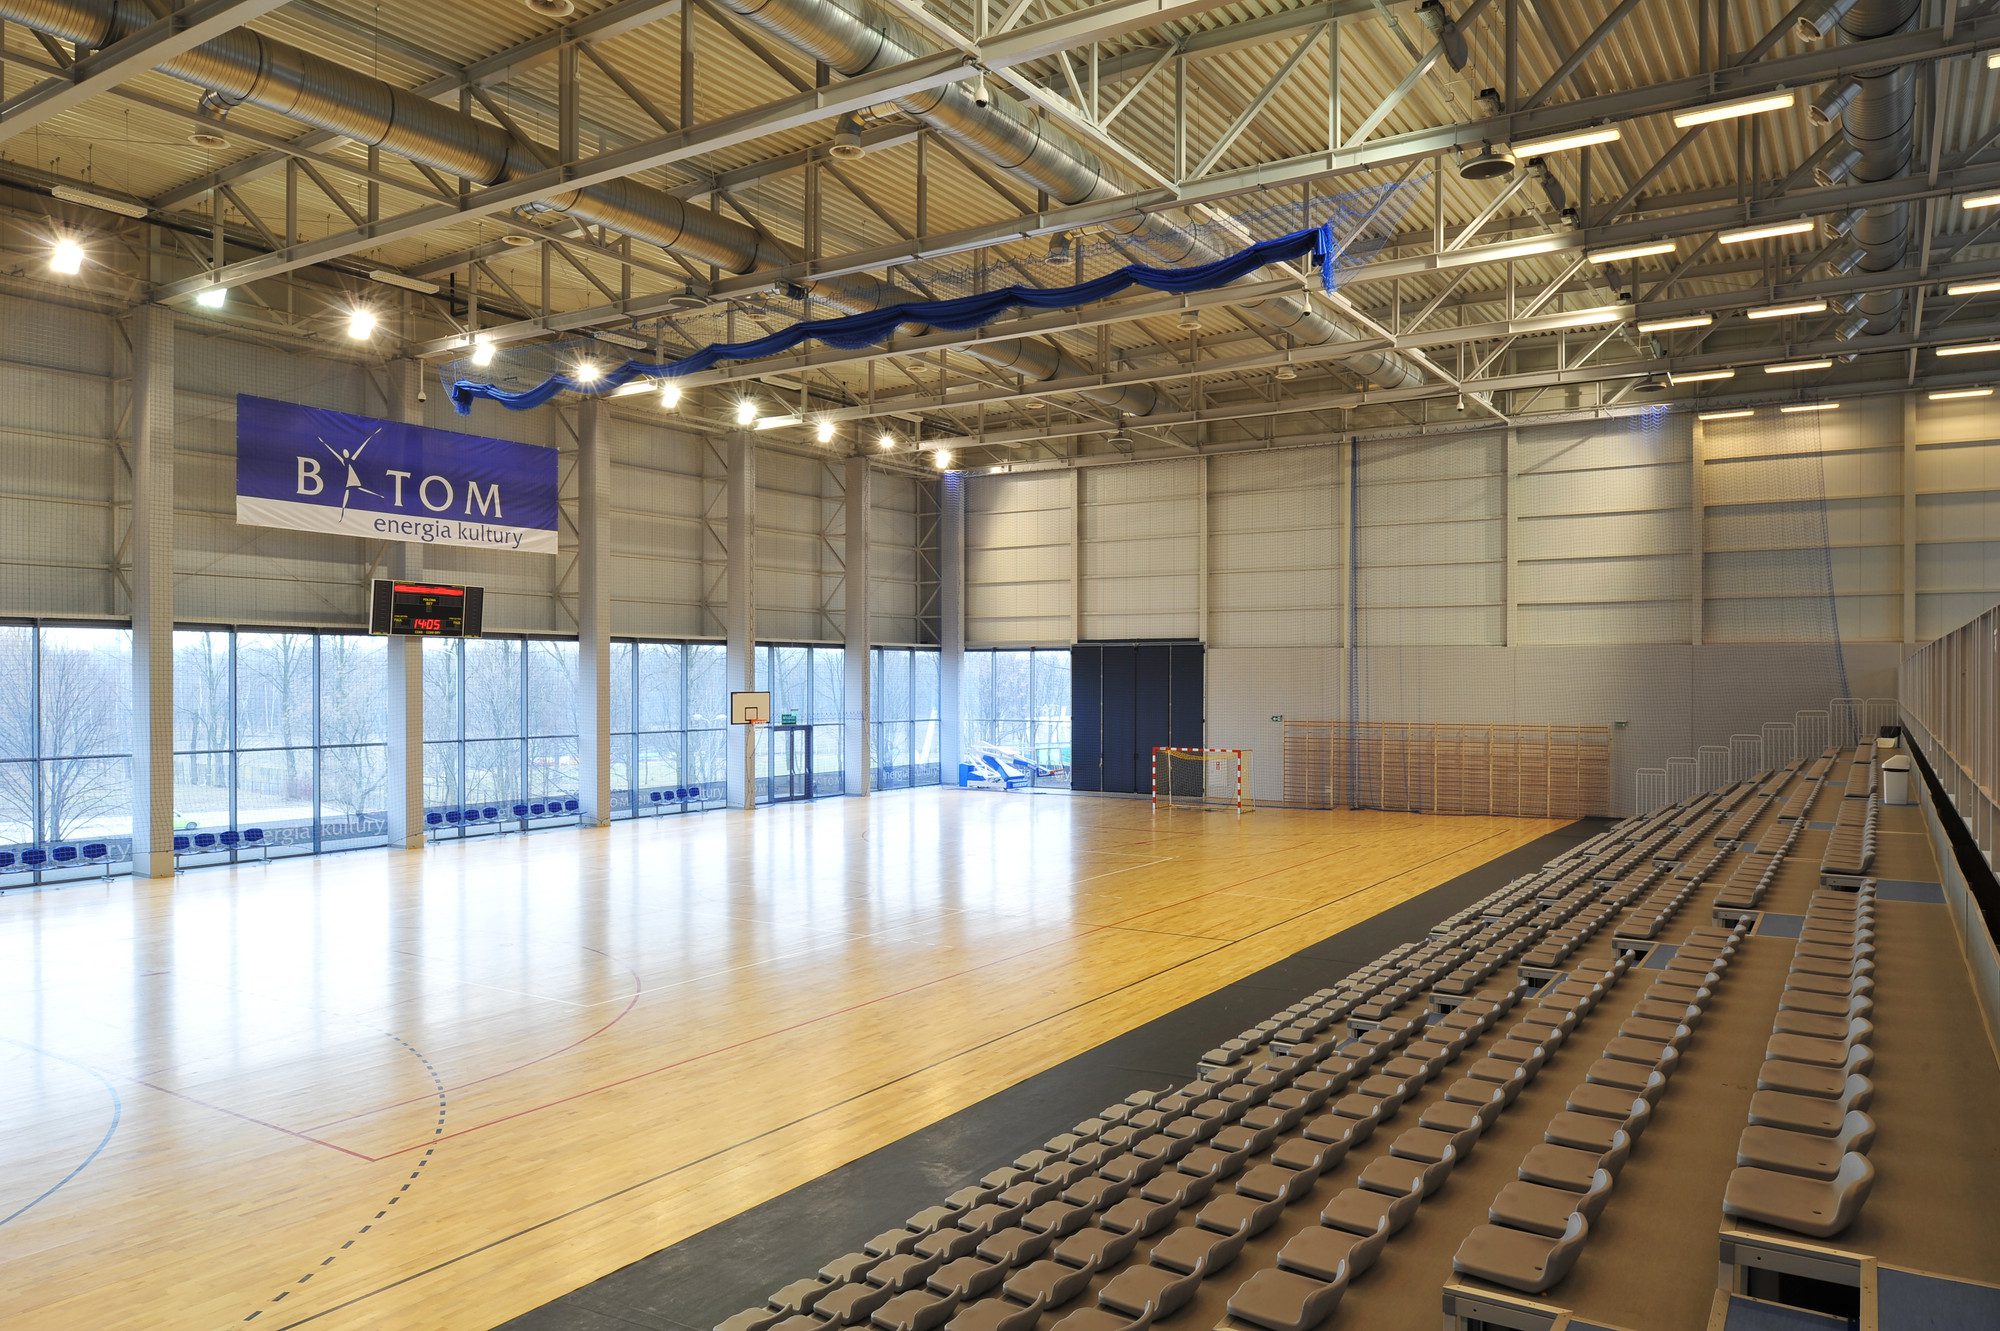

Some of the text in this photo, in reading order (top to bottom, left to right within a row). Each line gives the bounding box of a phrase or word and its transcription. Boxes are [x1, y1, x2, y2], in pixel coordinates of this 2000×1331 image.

[374, 517, 523, 549] energia kultury
[413, 618, 441, 630] 14:05
[321, 820, 384, 836] kultury
